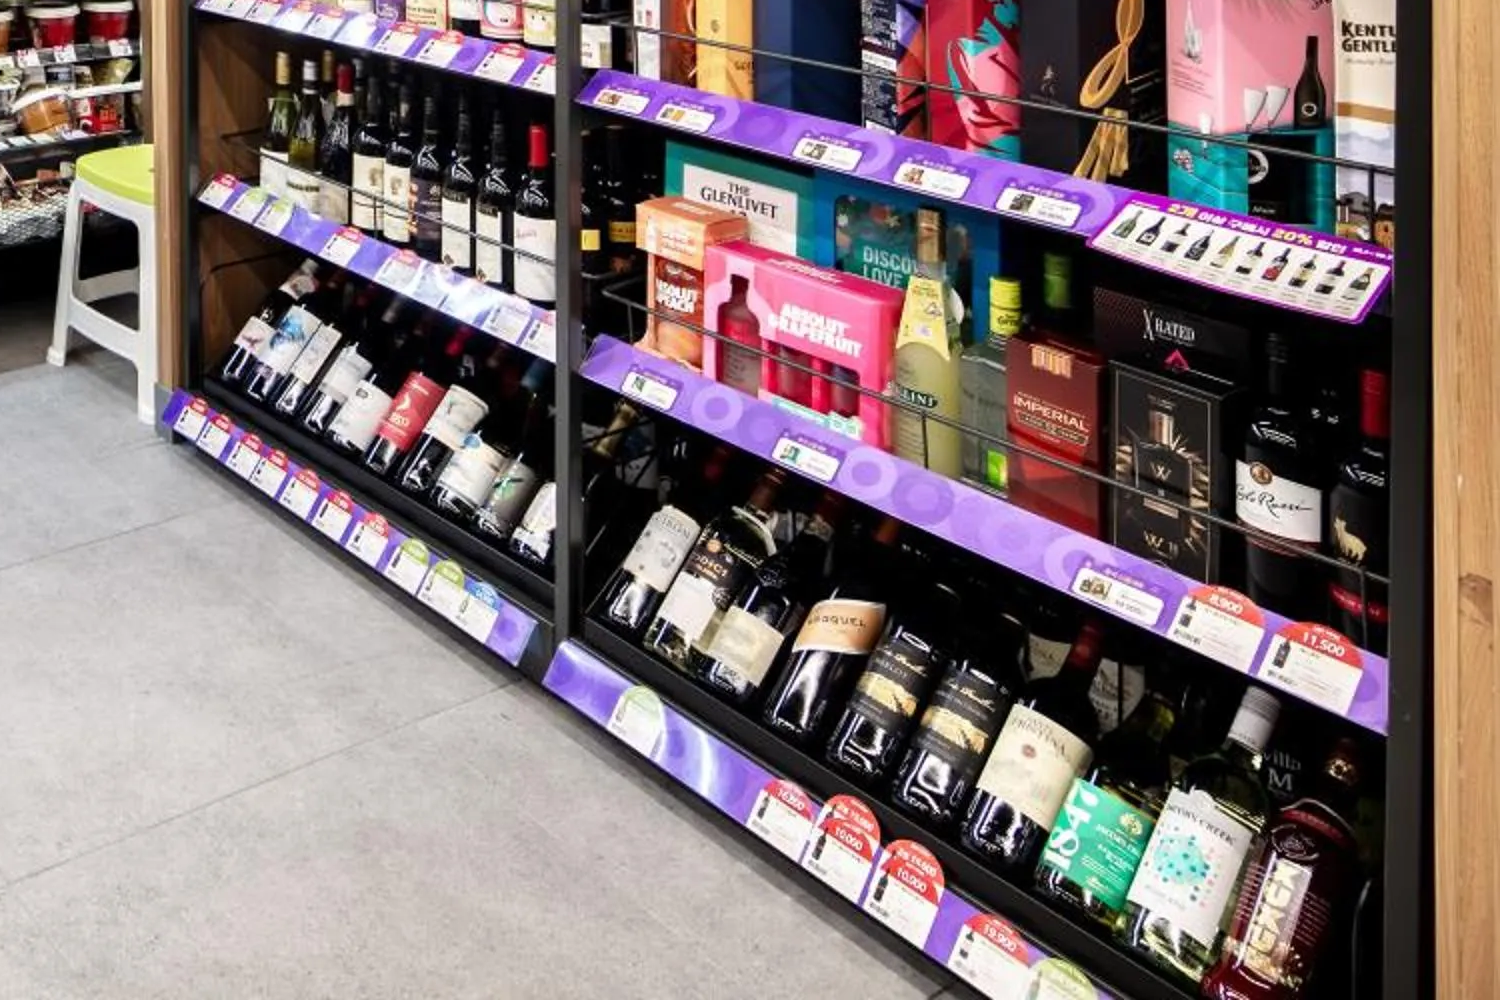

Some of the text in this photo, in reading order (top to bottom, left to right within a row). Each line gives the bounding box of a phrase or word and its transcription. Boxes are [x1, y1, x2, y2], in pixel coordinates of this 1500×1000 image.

[1341, 20, 1396, 37] KENTU
[1341, 38, 1396, 52] GENTLE
[726, 182, 751, 196] THE
[700, 186, 779, 219] GLENLIVET
[1271, 229, 1314, 247] 20%
[863, 246, 923, 276] DISCOV
[863, 265, 904, 289] LOVE
[781, 302, 848, 334] ABSOLUT
[1013, 393, 1089, 433] IMPERIAL
[1151, 462, 1172, 482] W
[1268, 767, 1294, 792] M
